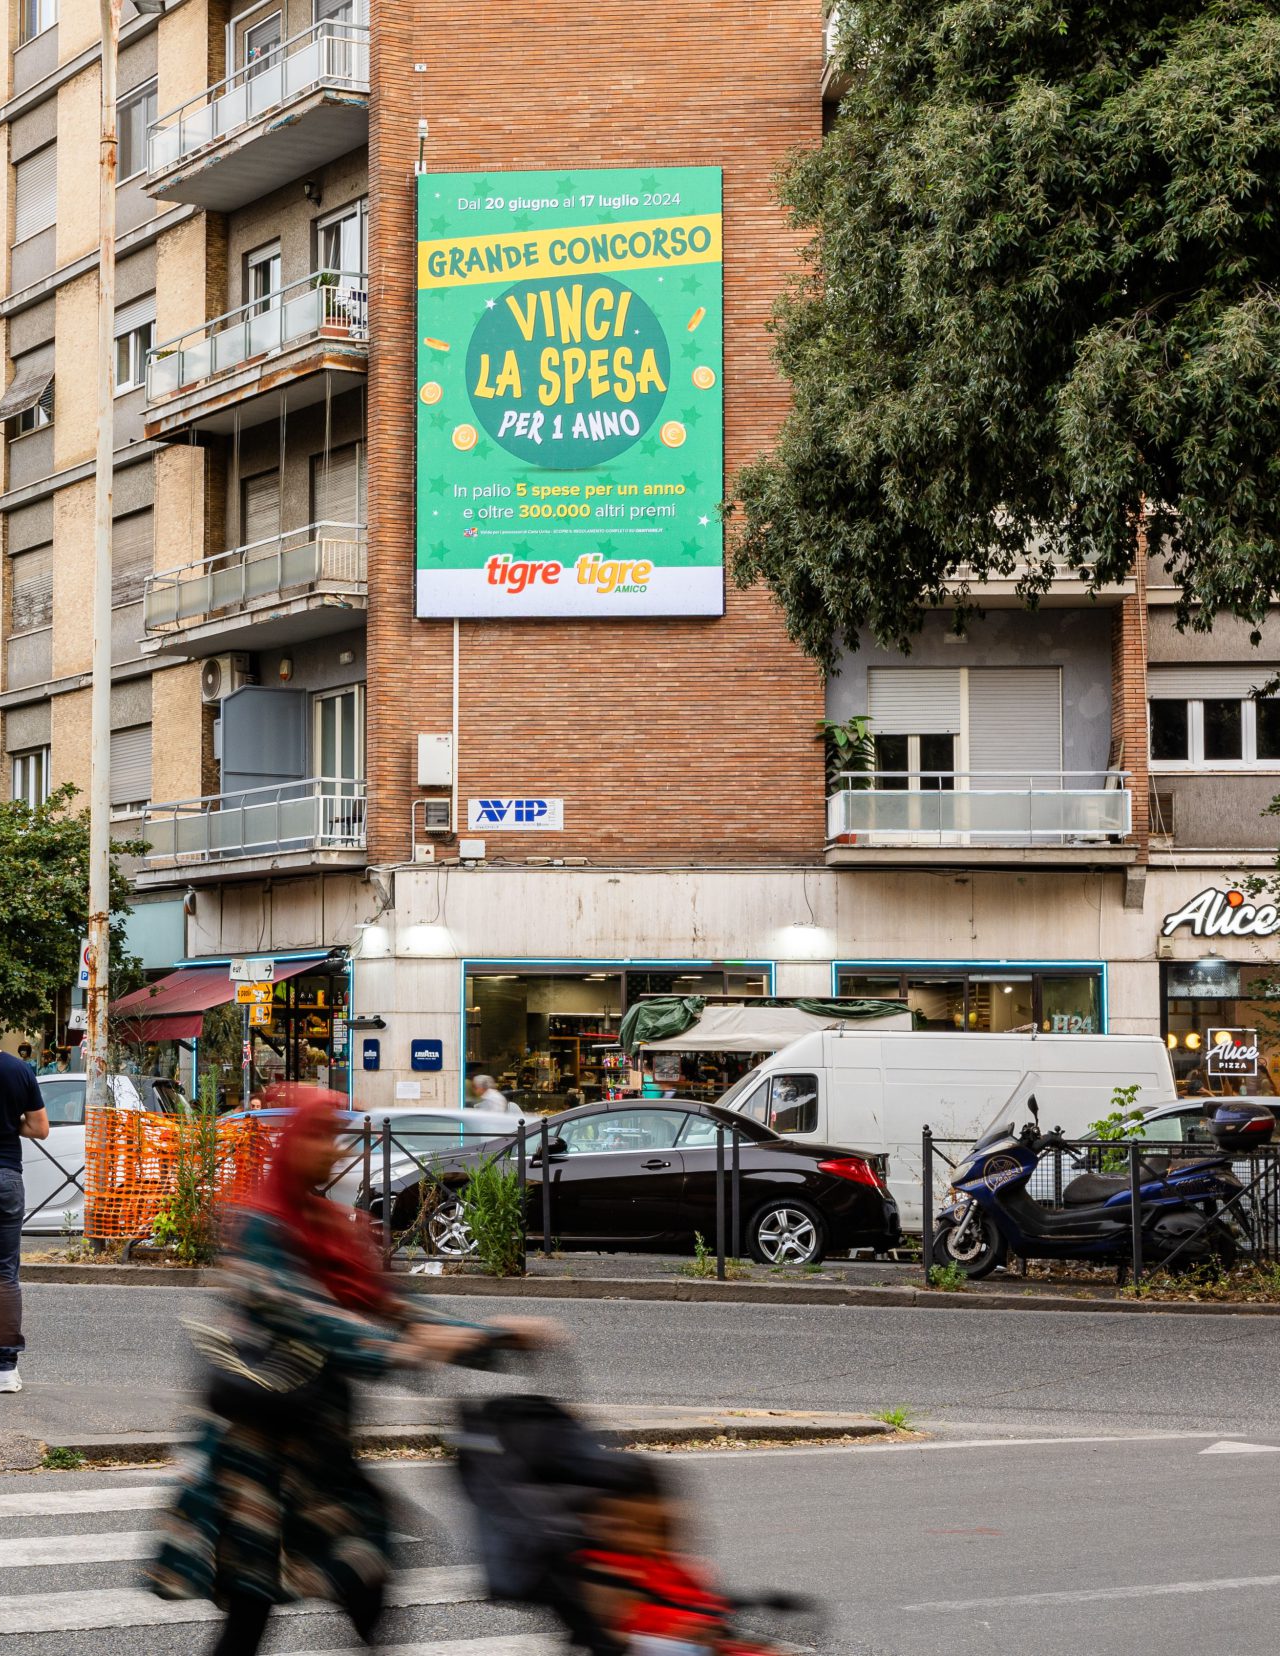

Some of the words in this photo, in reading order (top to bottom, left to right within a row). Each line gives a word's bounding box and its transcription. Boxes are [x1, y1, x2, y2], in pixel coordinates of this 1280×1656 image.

[458, 198, 481, 211] Dal
[485, 197, 506, 210] 20
[508, 196, 559, 211] giugno
[563, 195, 575, 208] al
[579, 195, 595, 208] 17
[599, 194, 639, 210] luglio
[643, 193, 681, 206] 2024
[428, 242, 539, 279] GRANDE
[549, 225, 712, 266] CONCORSO
[506, 284, 632, 344] VINCI
[474, 350, 522, 399] LA
[538, 347, 667, 406] SPESA
[497, 409, 544, 445] PER
[552, 411, 563, 440] 1
[571, 409, 640, 442] ANNO
[453, 484, 467, 498] In
[473, 483, 511, 502] palio
[516, 484, 527, 497] 5
[532, 485, 580, 501] spese
[585, 485, 613, 500] per
[618, 485, 639, 497] un
[643, 484, 686, 496] anno
[463, 509, 473, 519] e
[477, 506, 514, 519] oltre
[519, 504, 591, 518] 300.000
[595, 503, 625, 518] altri
[630, 503, 676, 520] premi
[487, 556, 561, 594] tigre
[576, 555, 652, 593] tigre
[614, 584, 648, 593] AMICO
[476, 800, 548, 822] AVIP
[1162, 888, 1280, 937] Alice
[1205, 1039, 1260, 1060] Alice
